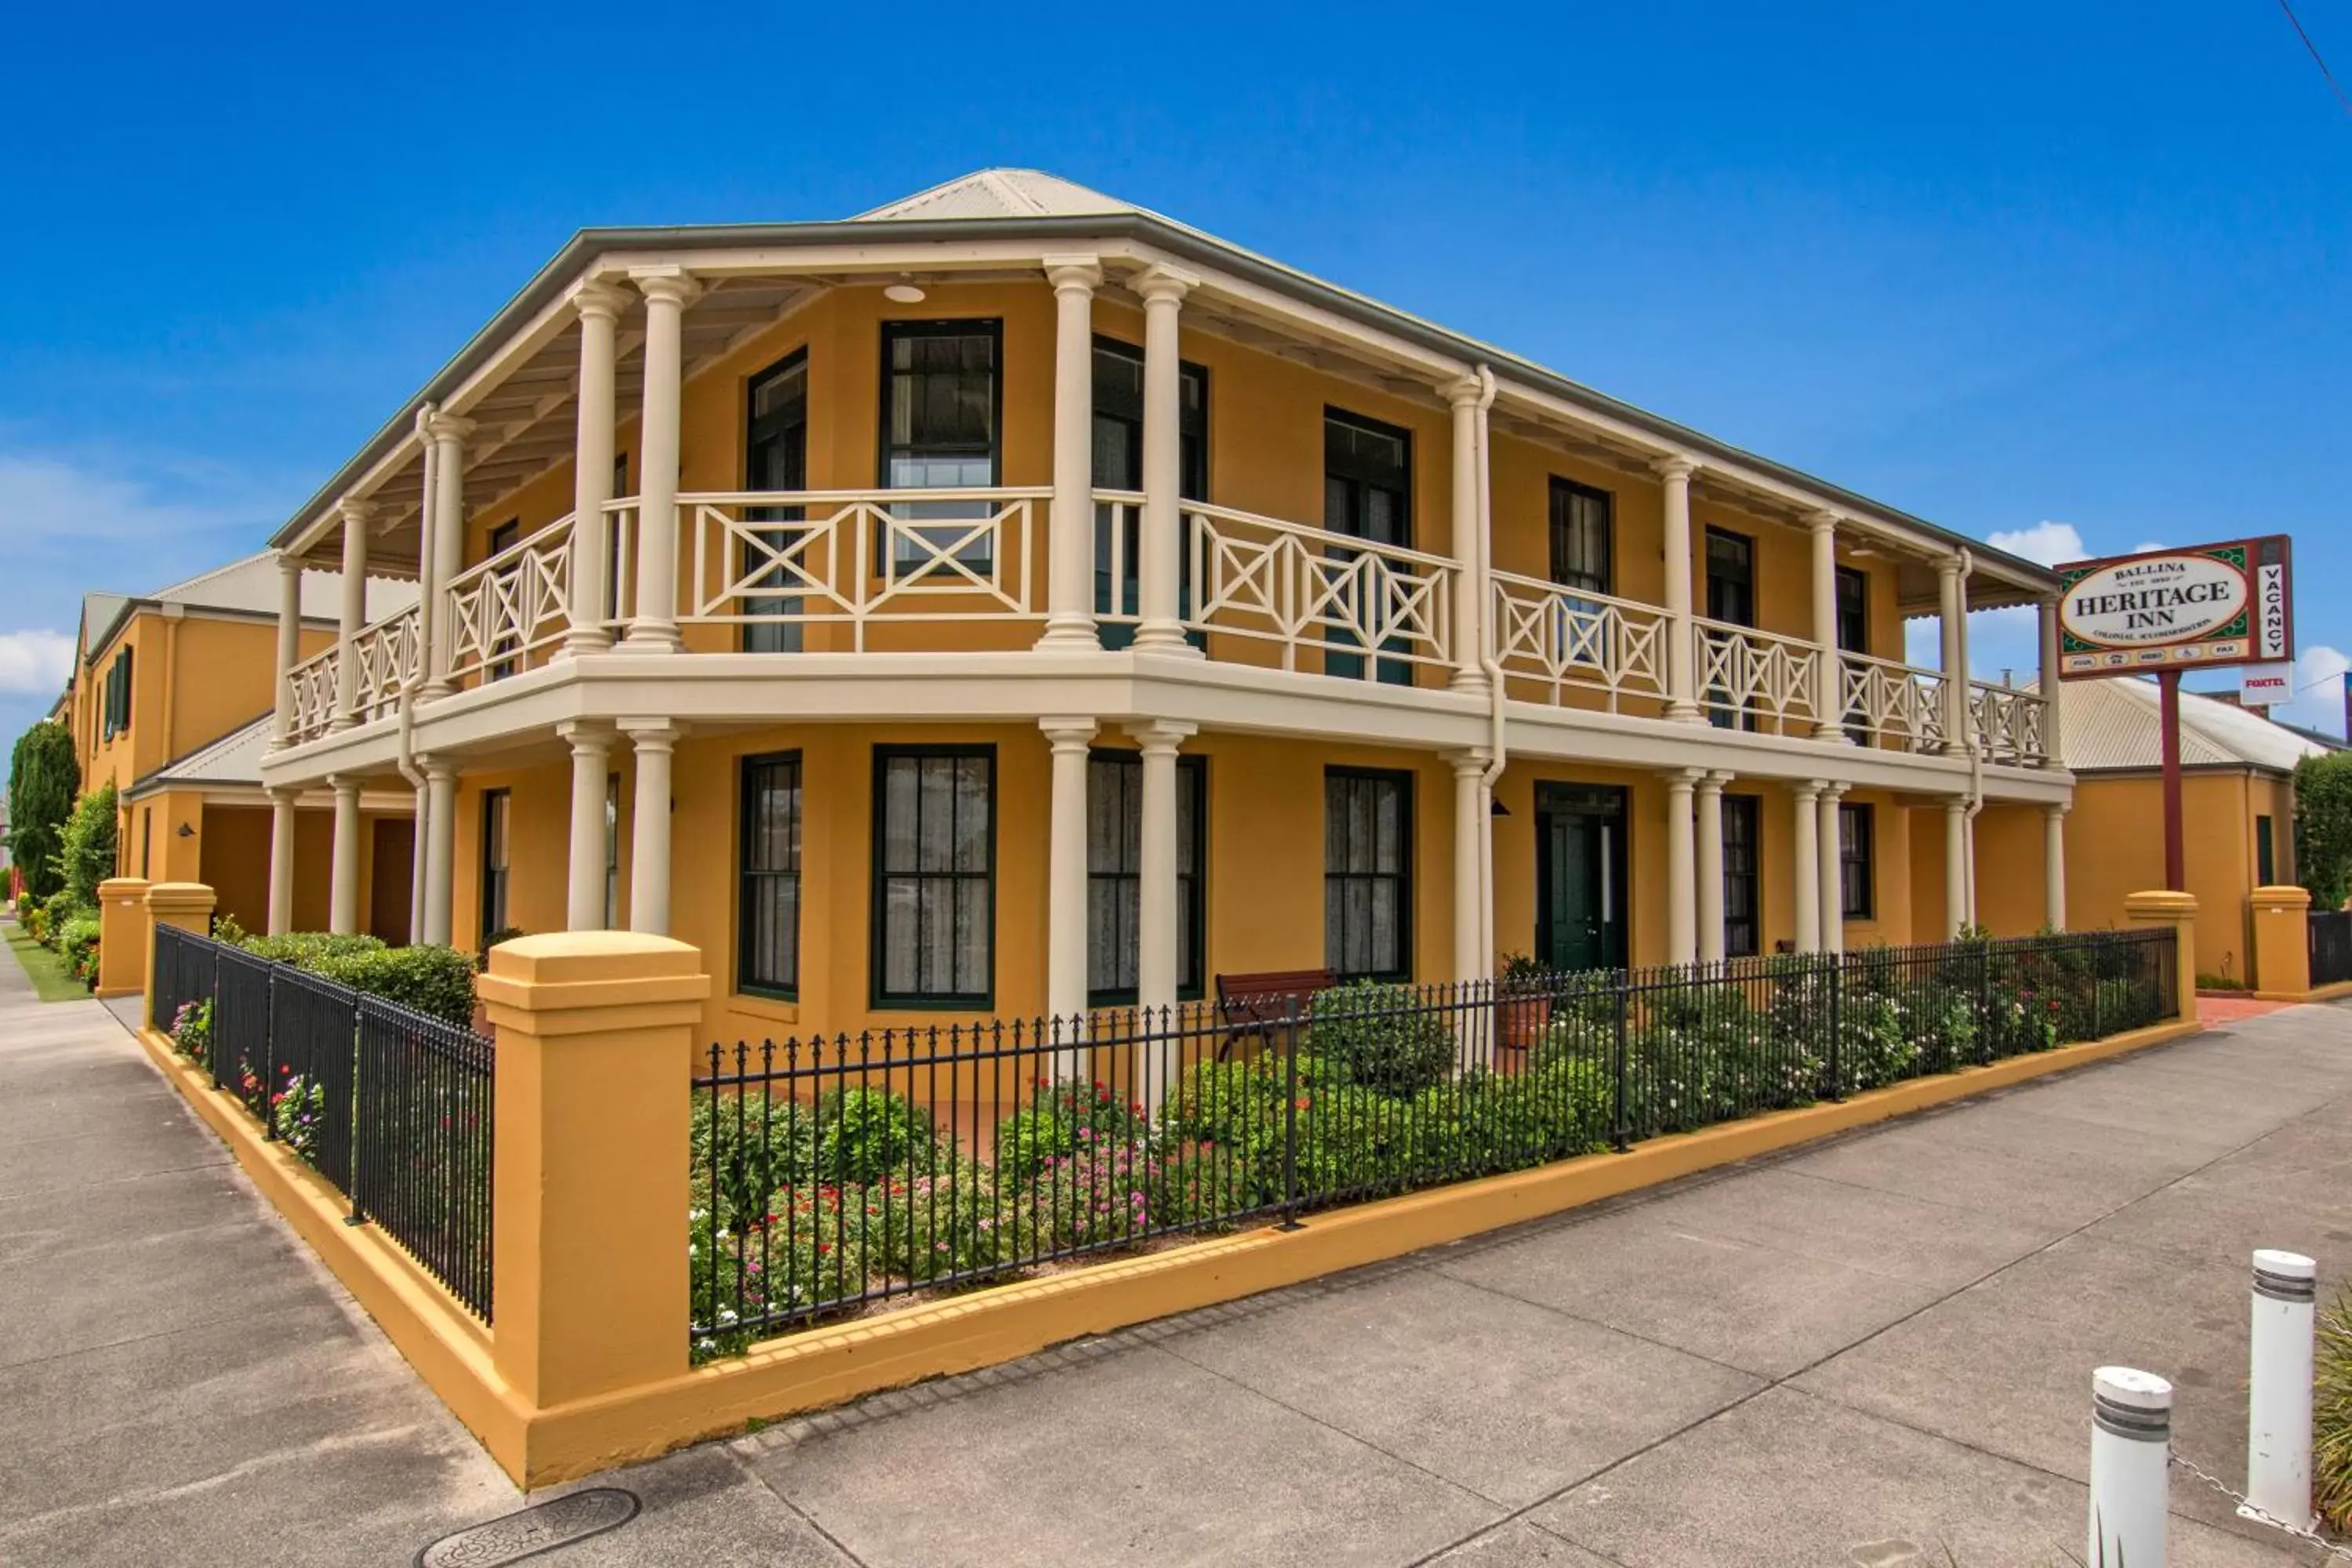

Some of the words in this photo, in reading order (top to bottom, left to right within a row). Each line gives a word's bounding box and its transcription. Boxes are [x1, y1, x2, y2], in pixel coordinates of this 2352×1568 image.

[2115, 562, 2186, 581] BALLINA
[2076, 581, 2229, 617] HERITAGE
[2126, 609, 2175, 630] INN
[2265, 569, 2282, 652] VACANCY
[2245, 677, 2285, 688] FOXTEL
